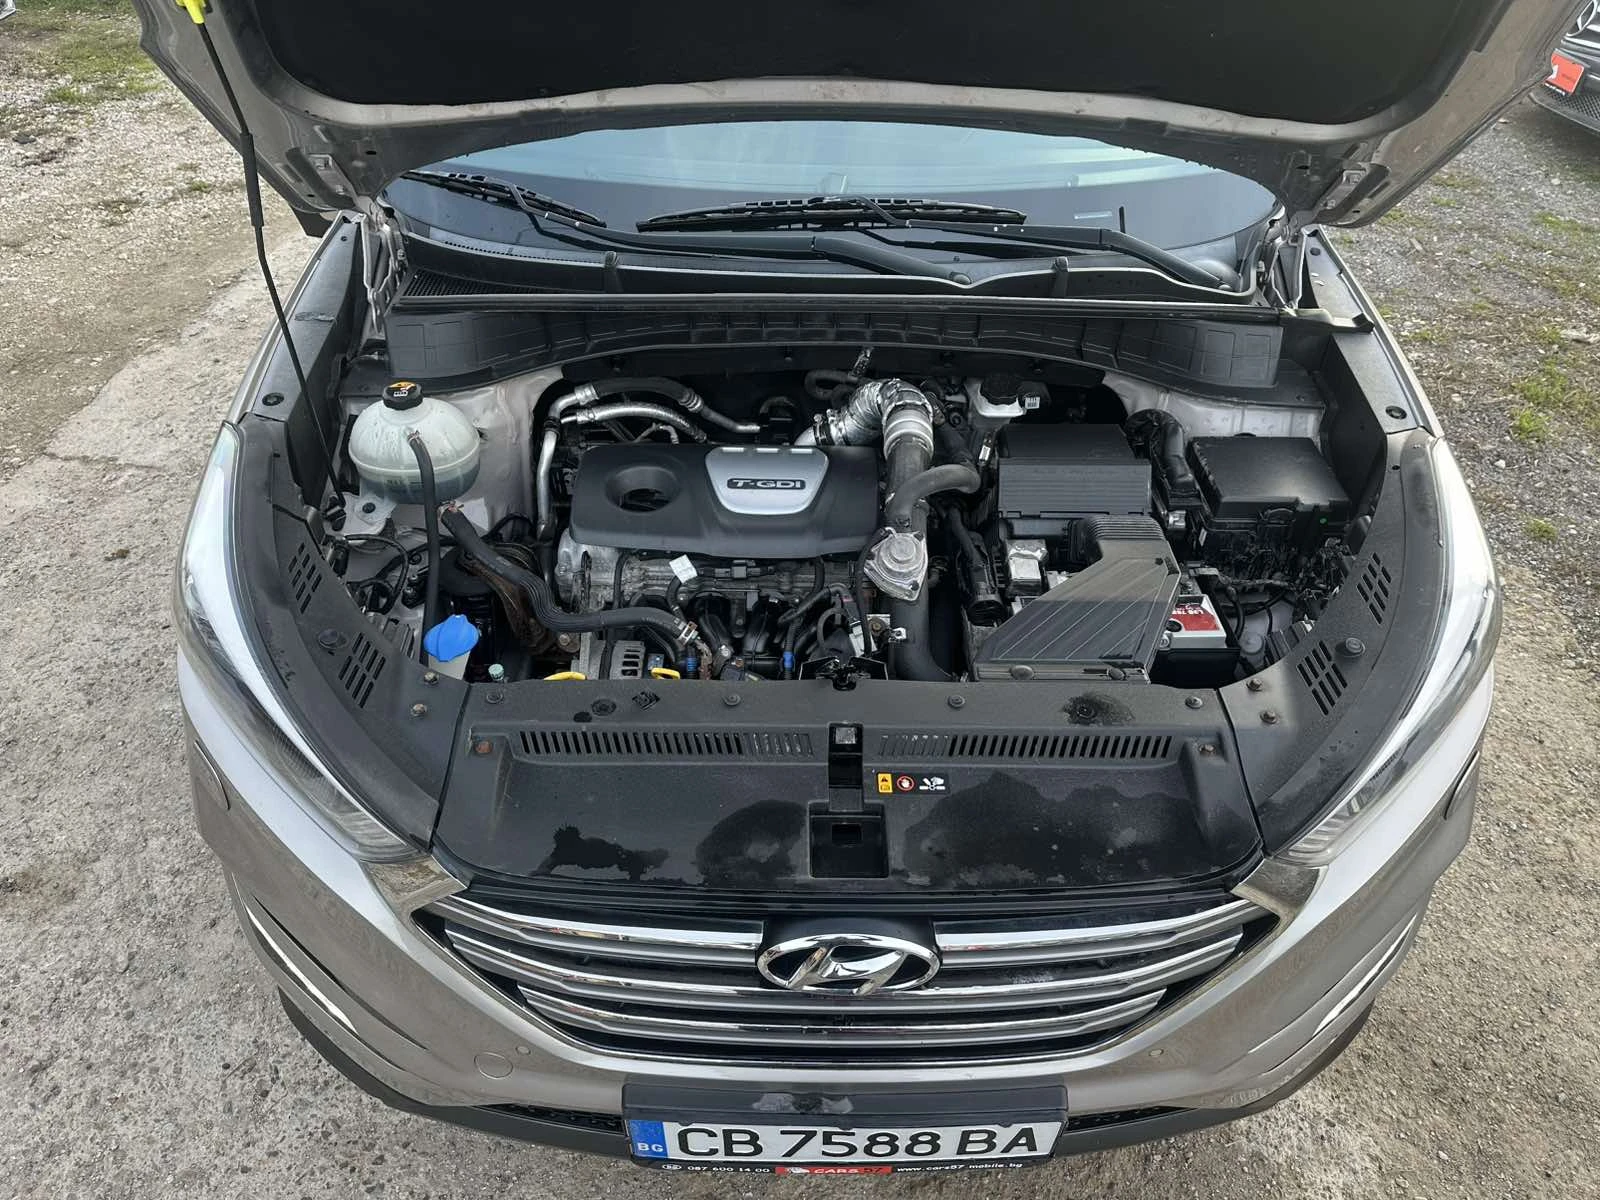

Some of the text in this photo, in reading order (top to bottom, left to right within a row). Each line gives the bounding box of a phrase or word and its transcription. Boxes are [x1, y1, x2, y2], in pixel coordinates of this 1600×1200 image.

[732, 479, 801, 488] T-GDI
[636, 1142, 664, 1153] BG
[677, 1127, 1038, 1158] CB 7588 BA
